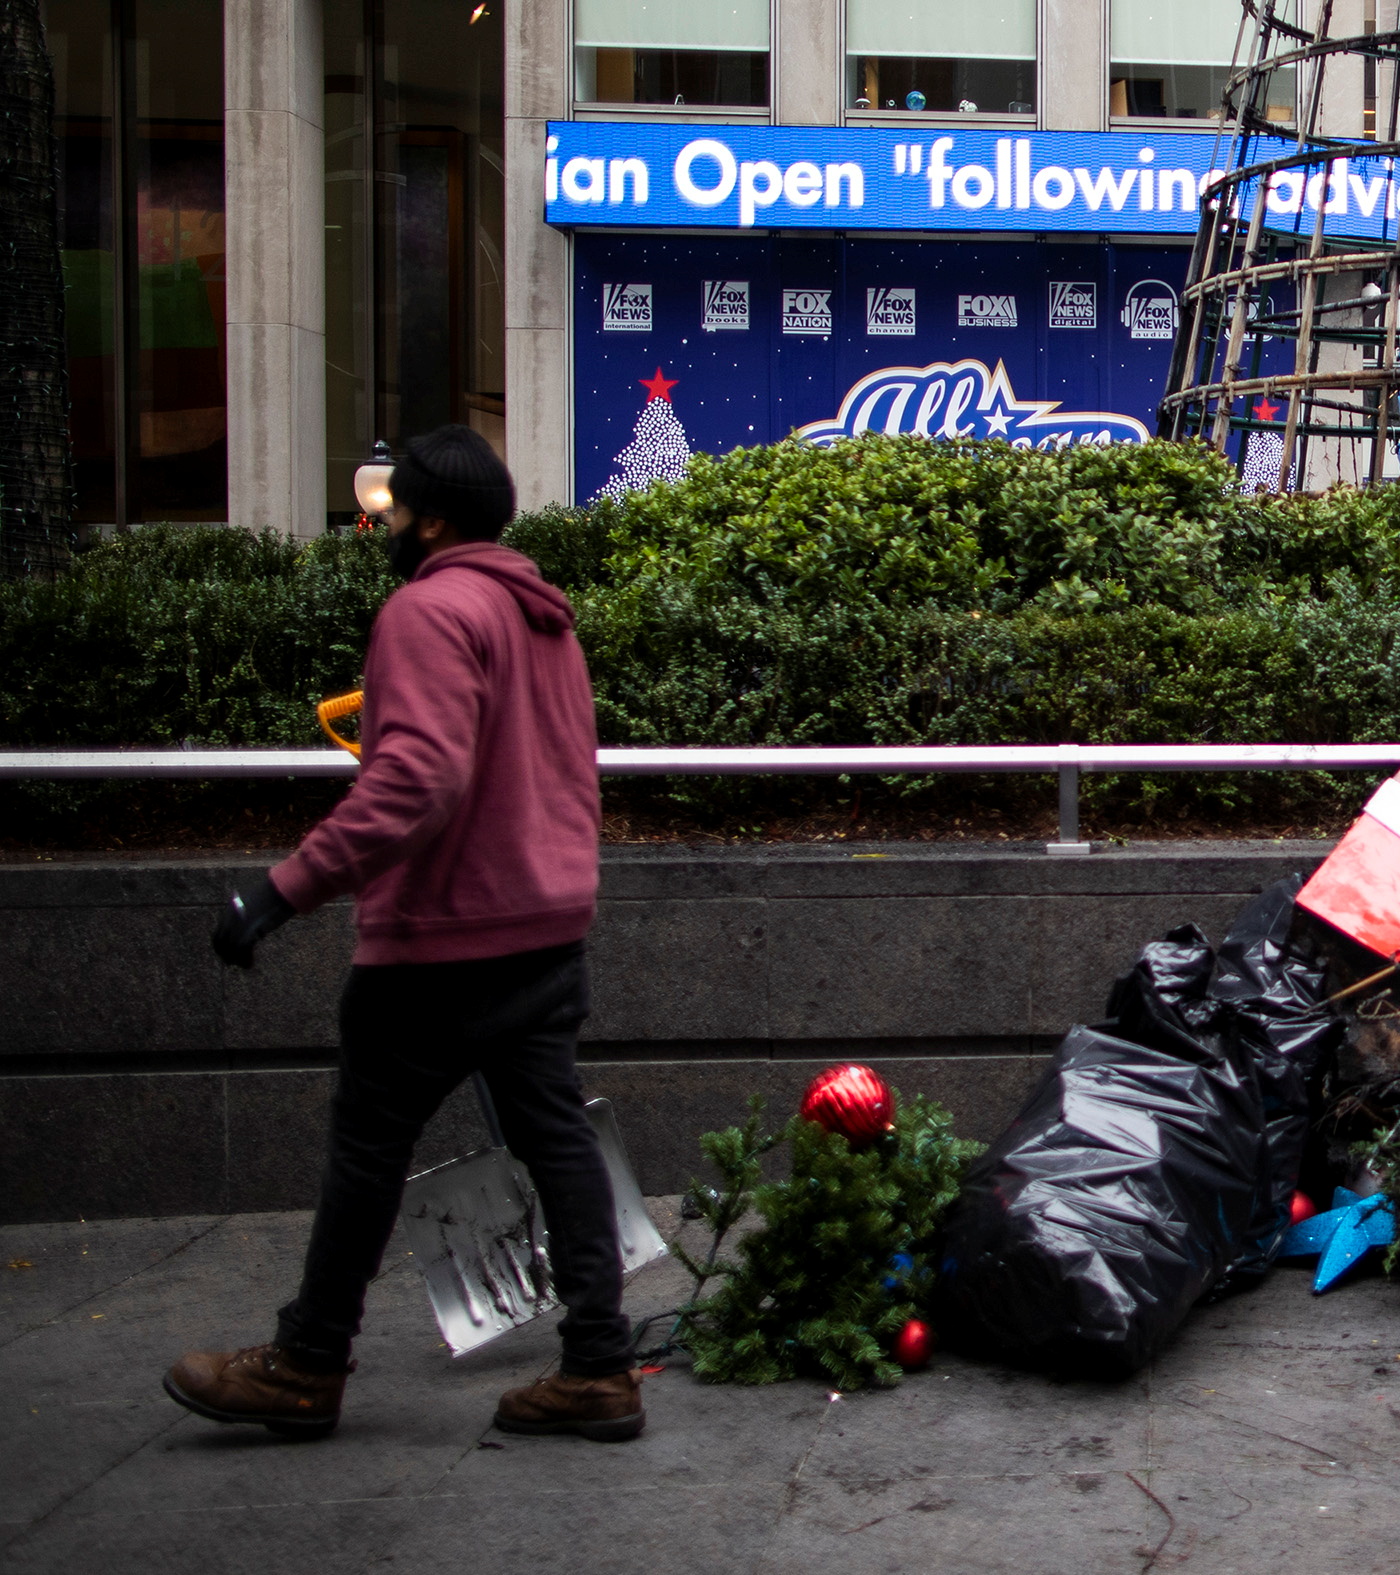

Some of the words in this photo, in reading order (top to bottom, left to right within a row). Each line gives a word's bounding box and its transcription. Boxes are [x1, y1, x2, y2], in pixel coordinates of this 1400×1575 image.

[546, 137, 648, 203] ian
[675, 139, 864, 227] Open
[620, 294, 650, 307] FOX
[720, 291, 746, 303] FOX
[783, 292, 831, 313] FOX
[1065, 293, 1093, 305] FOX
[711, 303, 747, 314] NEWS
[883, 299, 913, 311] FOX
[958, 295, 1008, 316] FOX
[1057, 305, 1094, 317] NEWS
[611, 308, 651, 320] NEWS
[874, 312, 914, 324] NEWS
[1145, 307, 1170, 318] FOX
[783, 316, 831, 327] NATION
[958, 318, 1018, 327] BUSINESS
[1137, 319, 1171, 329] NEWS
